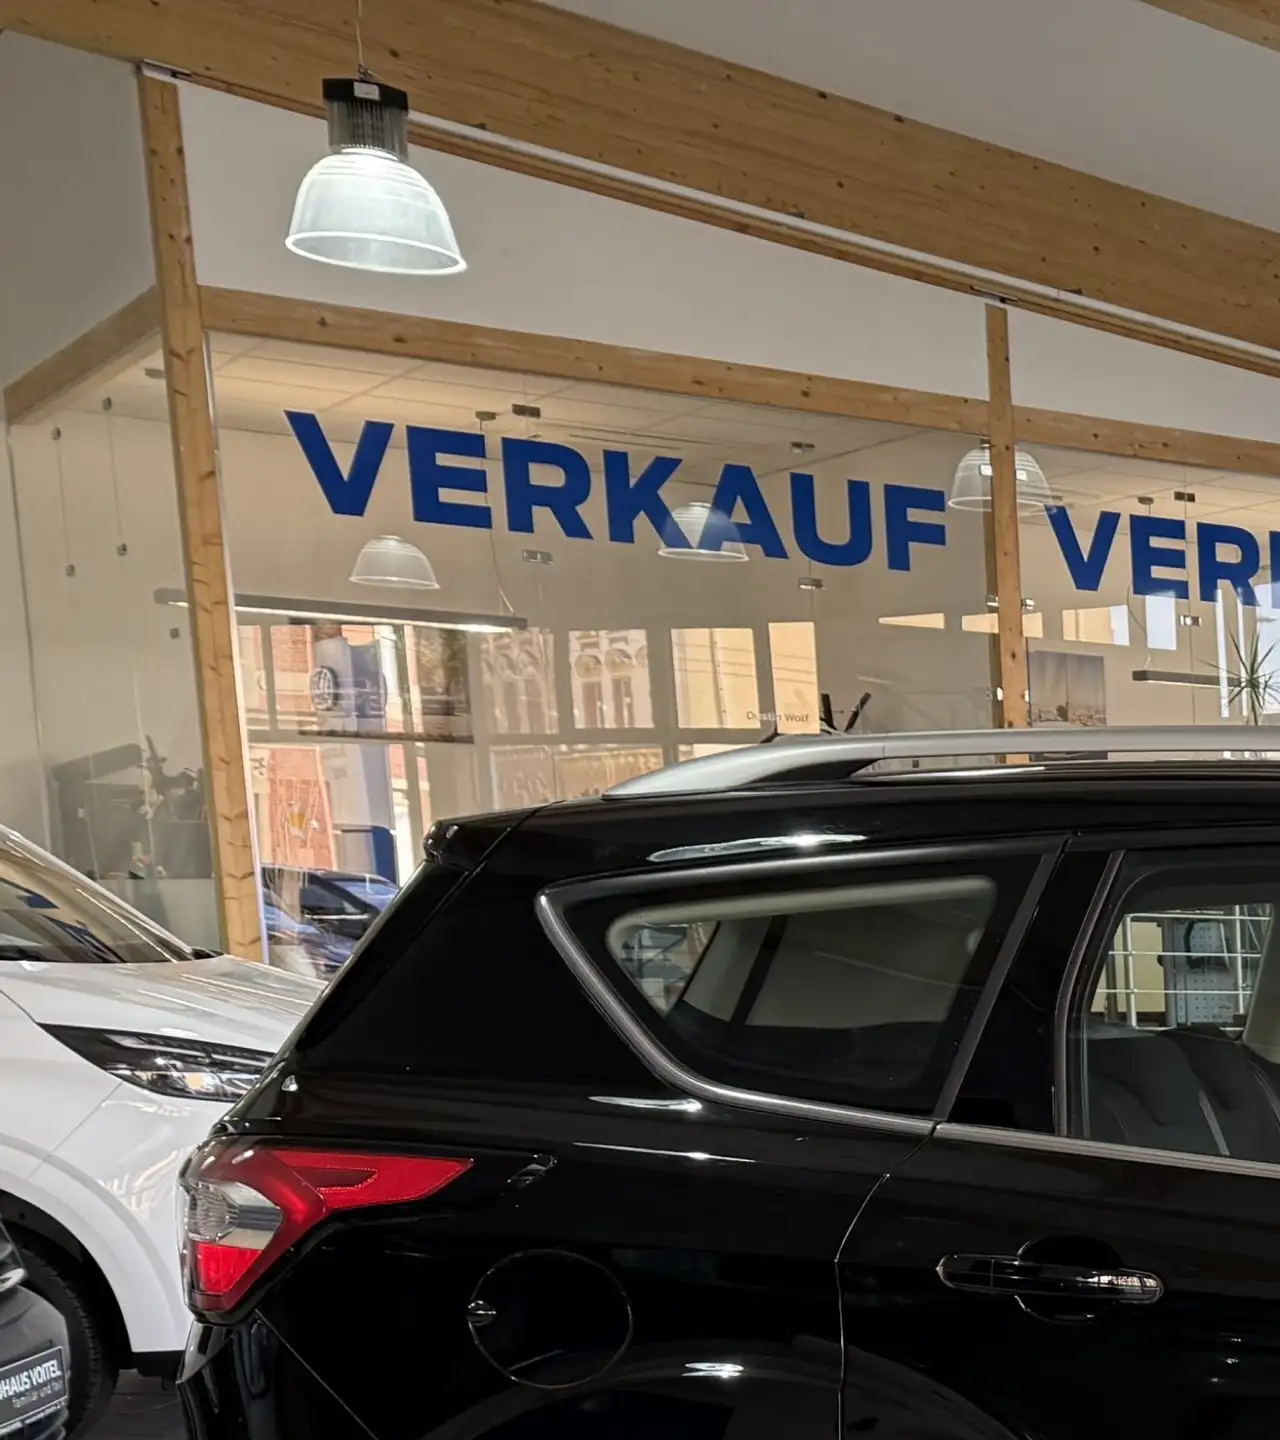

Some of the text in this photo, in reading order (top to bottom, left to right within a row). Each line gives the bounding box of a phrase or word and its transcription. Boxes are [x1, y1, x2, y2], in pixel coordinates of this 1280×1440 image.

[284, 410, 947, 572] VERKAUF
[784, 713, 809, 722] Wolf
[29, 1359, 62, 1386] VOITEL
